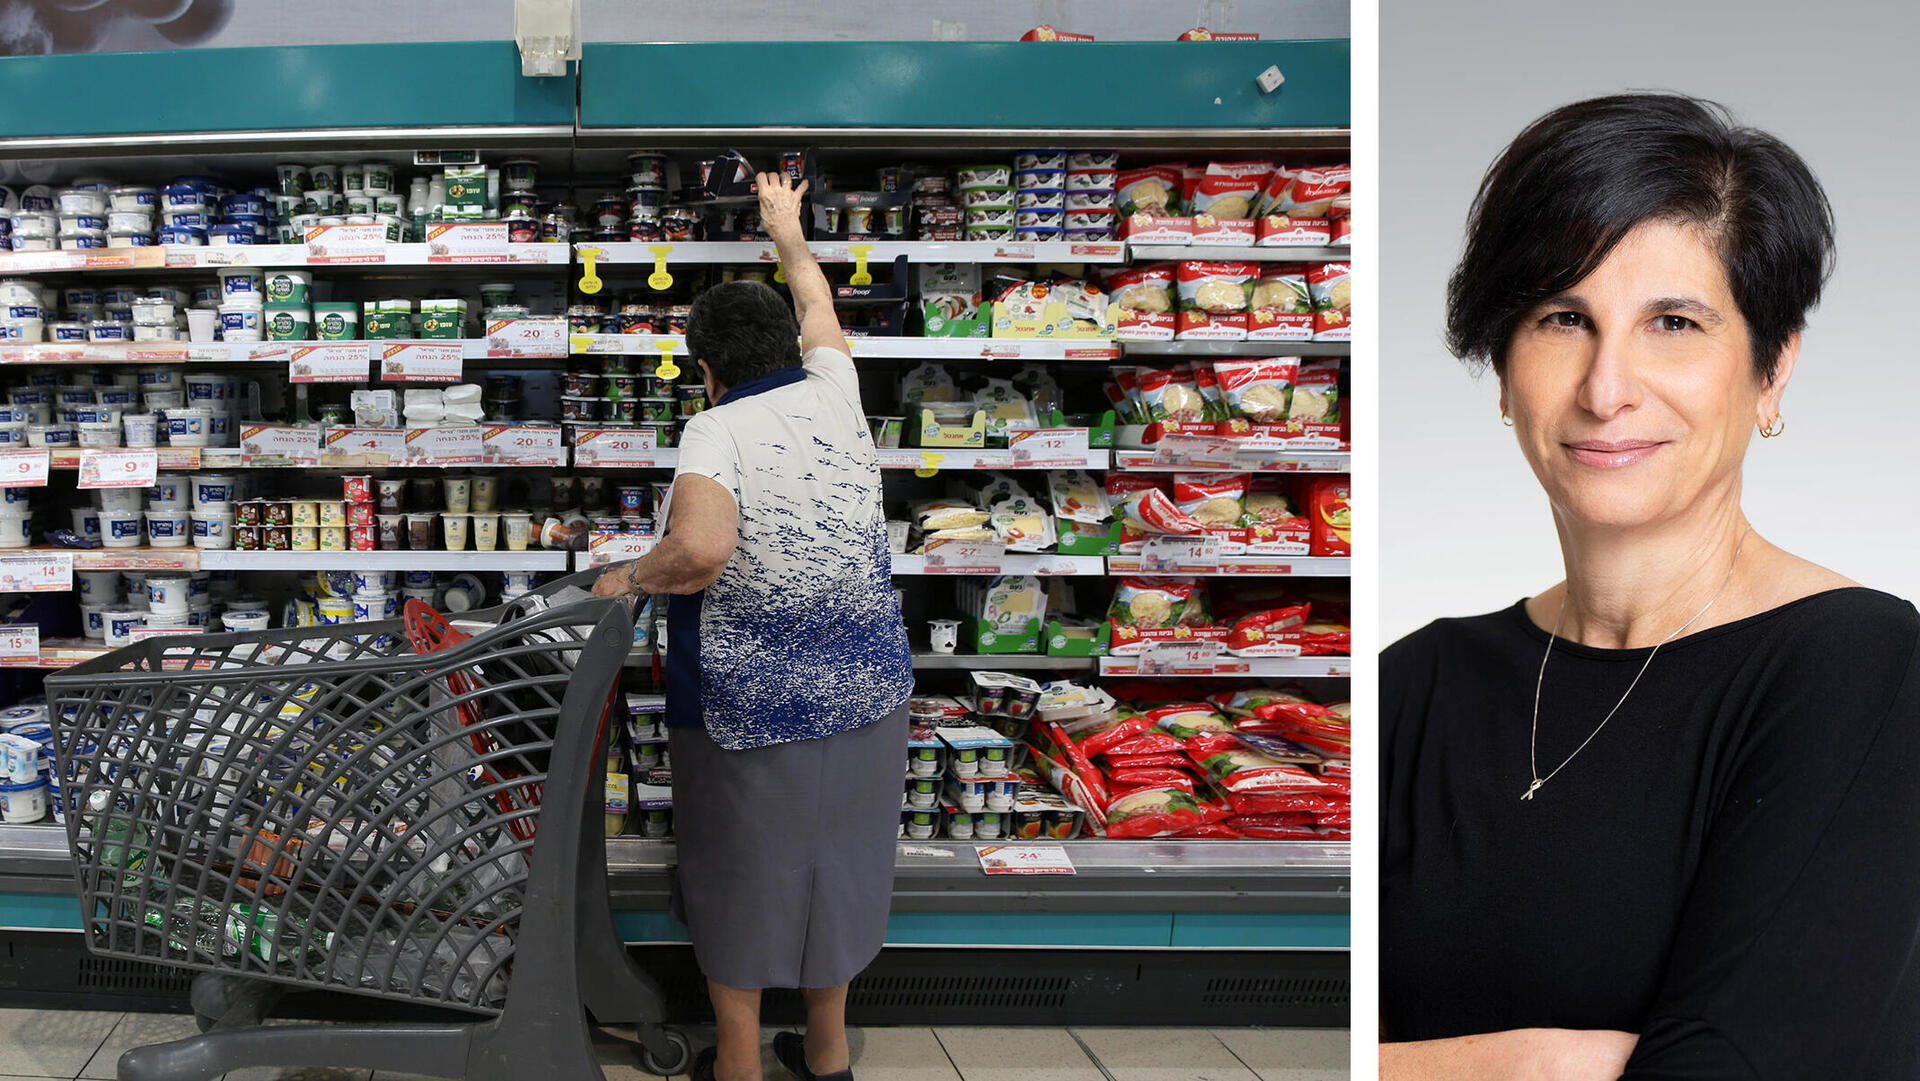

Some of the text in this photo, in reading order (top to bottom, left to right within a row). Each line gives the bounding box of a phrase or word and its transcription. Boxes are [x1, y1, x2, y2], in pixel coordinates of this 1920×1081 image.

[554, 329, 560, 337] 5
[547, 438, 552, 446] 5
[642, 441, 649, 450] 5
[1206, 444, 1220, 454] 7
[18, 462, 30, 473] 9
[125, 461, 137, 472] 9
[627, 495, 638, 505] 12
[1188, 547, 1202, 558] 14
[43, 566, 55, 576] 14
[9, 638, 22, 648] 15
[1186, 651, 1199, 660] 14
